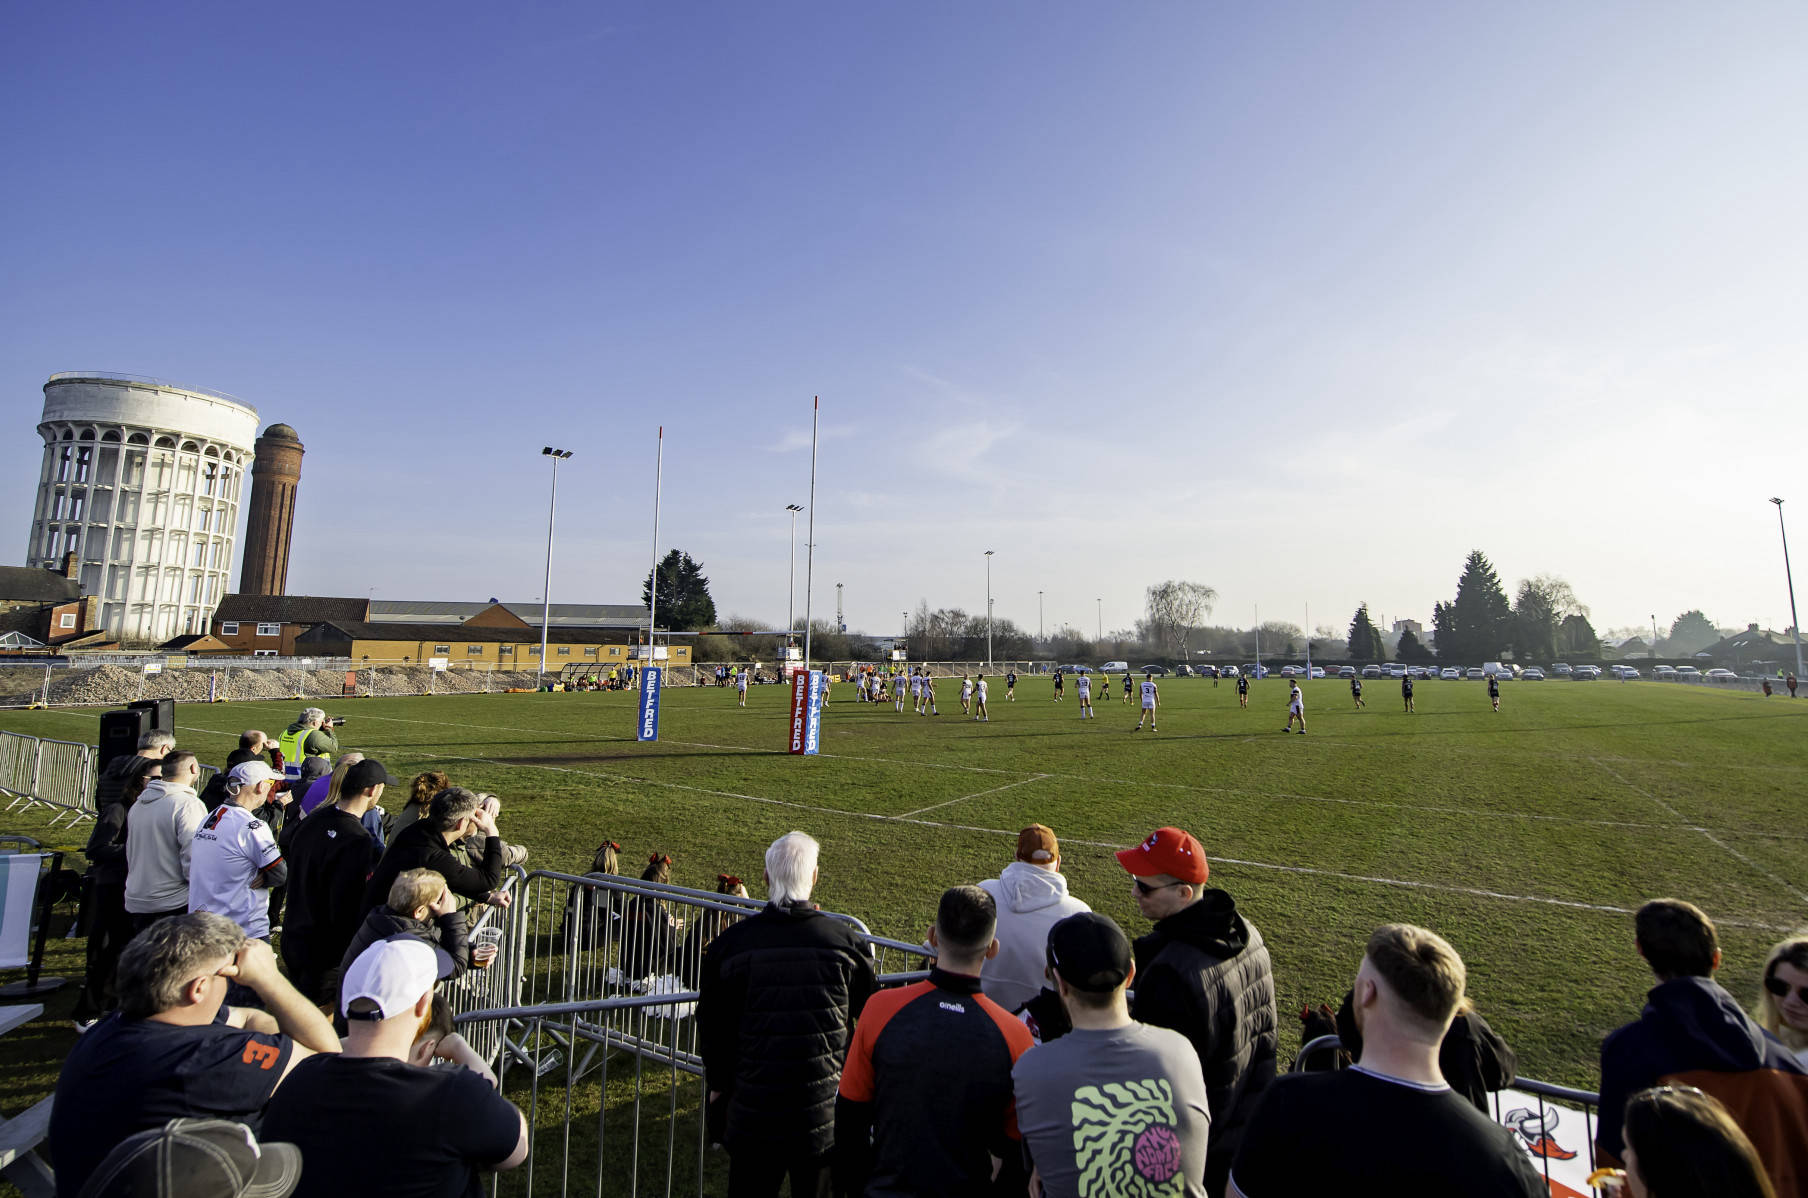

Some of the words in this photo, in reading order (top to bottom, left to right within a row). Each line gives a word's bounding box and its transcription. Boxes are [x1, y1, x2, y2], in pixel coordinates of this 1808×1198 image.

[643, 670, 657, 738] BETFRED
[792, 674, 805, 751] BETFRED
[808, 674, 819, 751] BETFRED
